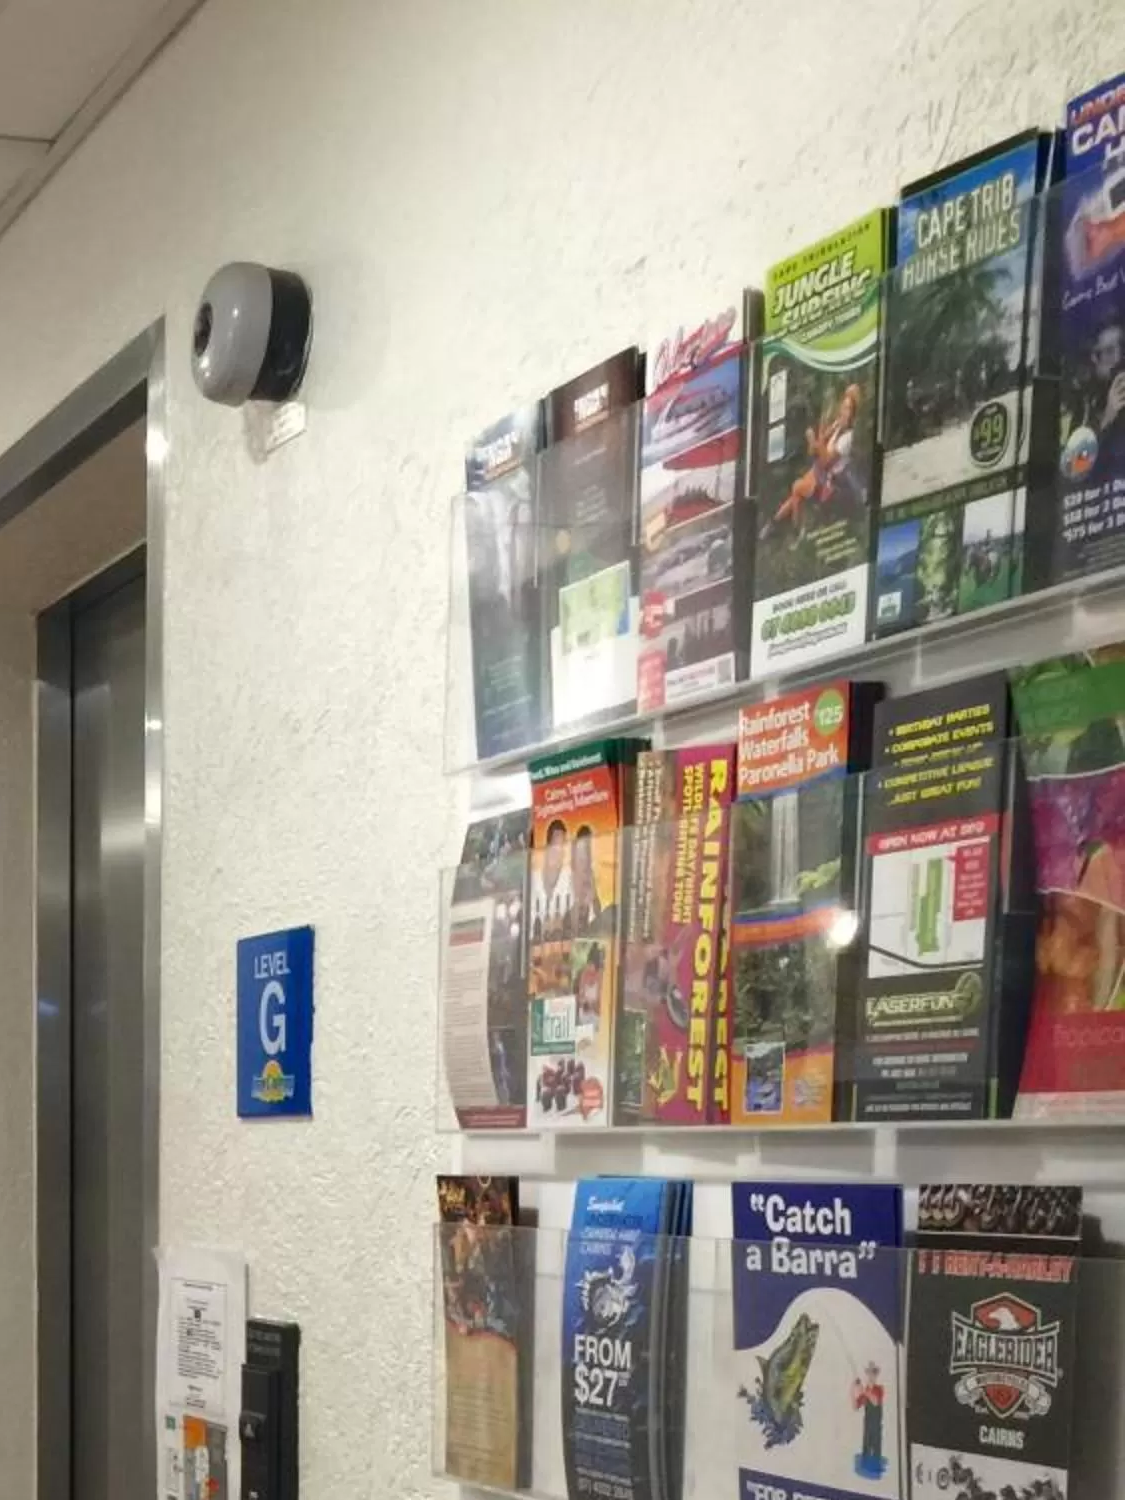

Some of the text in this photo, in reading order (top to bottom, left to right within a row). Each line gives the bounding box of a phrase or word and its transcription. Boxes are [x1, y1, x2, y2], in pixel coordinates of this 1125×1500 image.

[917, 173, 1015, 248] CAPE TRIB
[901, 211, 1020, 291] HORSE RIDES
[772, 249, 857, 317] JUNGLE
[739, 702, 810, 736] Rainforest
[739, 727, 809, 762] Waterfalls
[739, 743, 840, 787] Paronella Park
[686, 759, 728, 1113] RAINFOREST
[254, 951, 292, 979] LEVEL
[259, 979, 287, 1056] G
[750, 1193, 852, 1236] "Catch
[746, 1236, 876, 1279] a Barra"
[575, 1334, 633, 1370] FROM
[953, 1324, 1058, 1375] EAGLERIDER
[575, 1363, 618, 1407] $27
[979, 1425, 1025, 1450] CAIRNS
